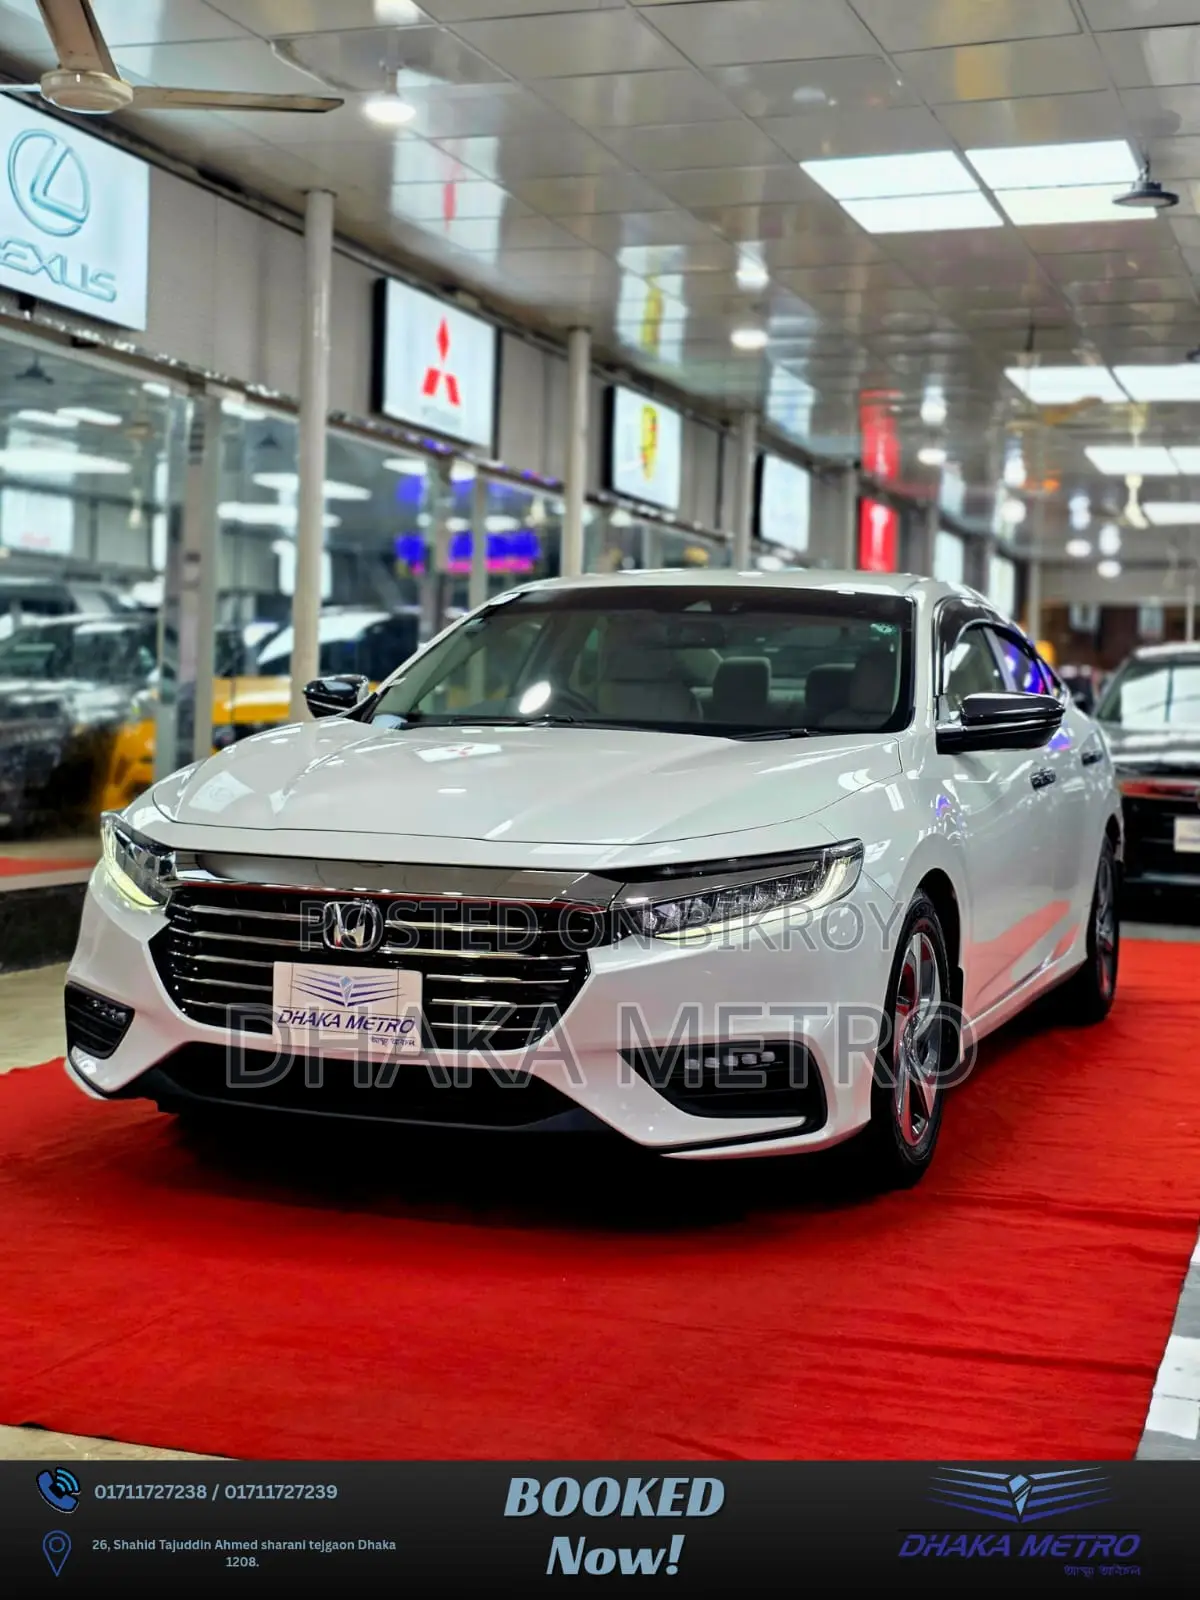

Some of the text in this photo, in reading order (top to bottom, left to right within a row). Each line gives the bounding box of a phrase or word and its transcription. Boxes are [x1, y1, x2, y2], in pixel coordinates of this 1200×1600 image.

[0, 238, 117, 303] EXUS
[278, 1009, 415, 1035] DHAKA METRO
